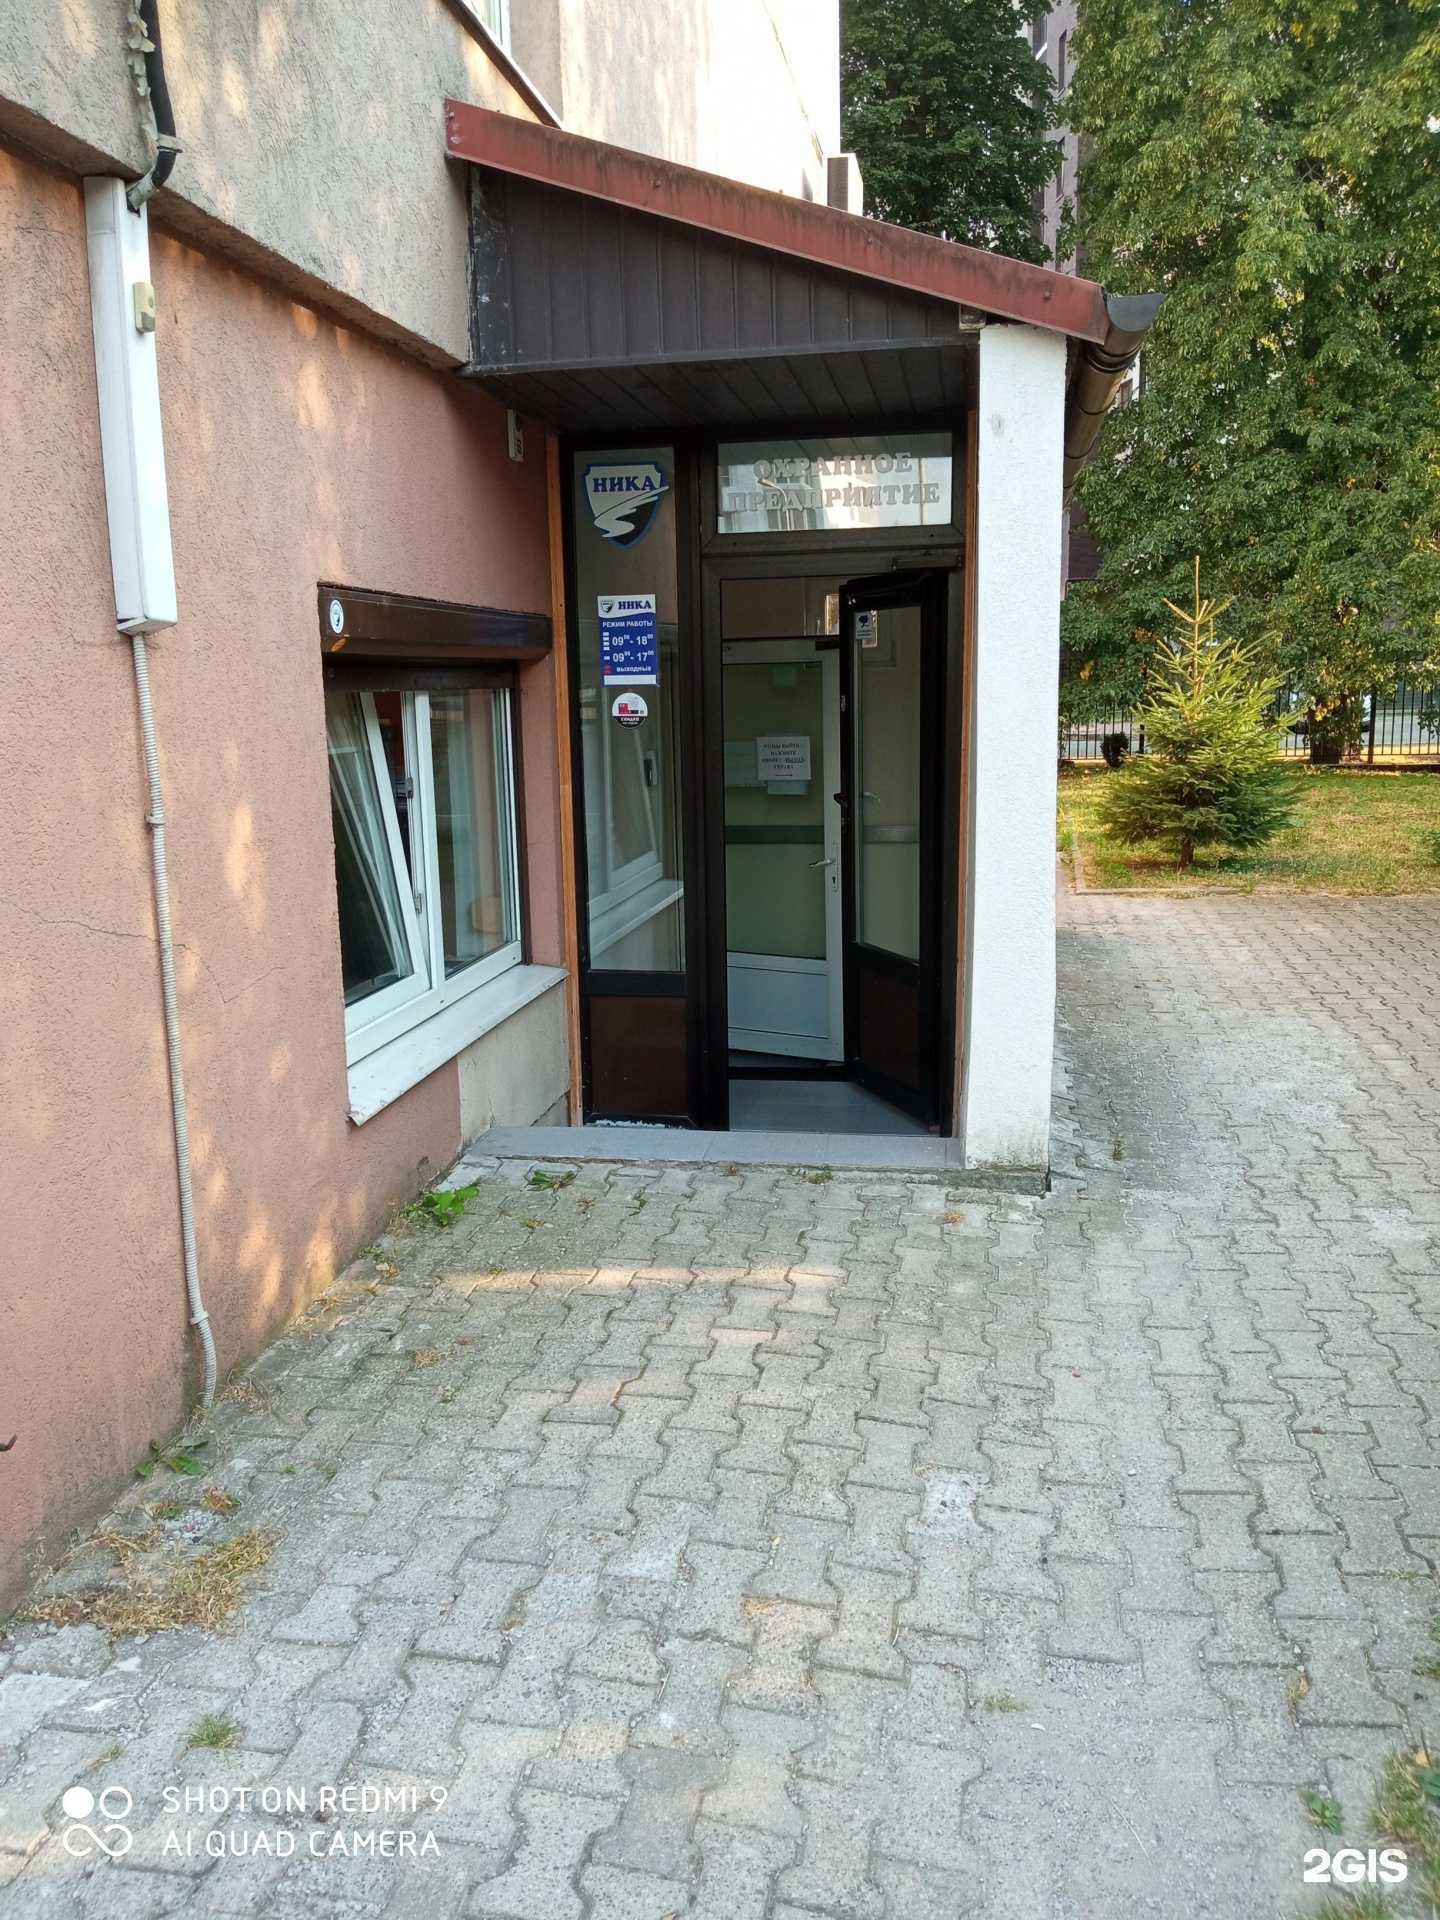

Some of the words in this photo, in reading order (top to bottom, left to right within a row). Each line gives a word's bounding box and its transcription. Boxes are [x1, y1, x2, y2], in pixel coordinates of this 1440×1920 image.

[753, 452, 912, 479] ОХРАННОЕ
[593, 475, 656, 492] НИКА
[723, 482, 940, 512] ПРЕДПРИЯТИЕ
[618, 600, 652, 610] НИКА
[626, 620, 653, 628] РАБОТЫ
